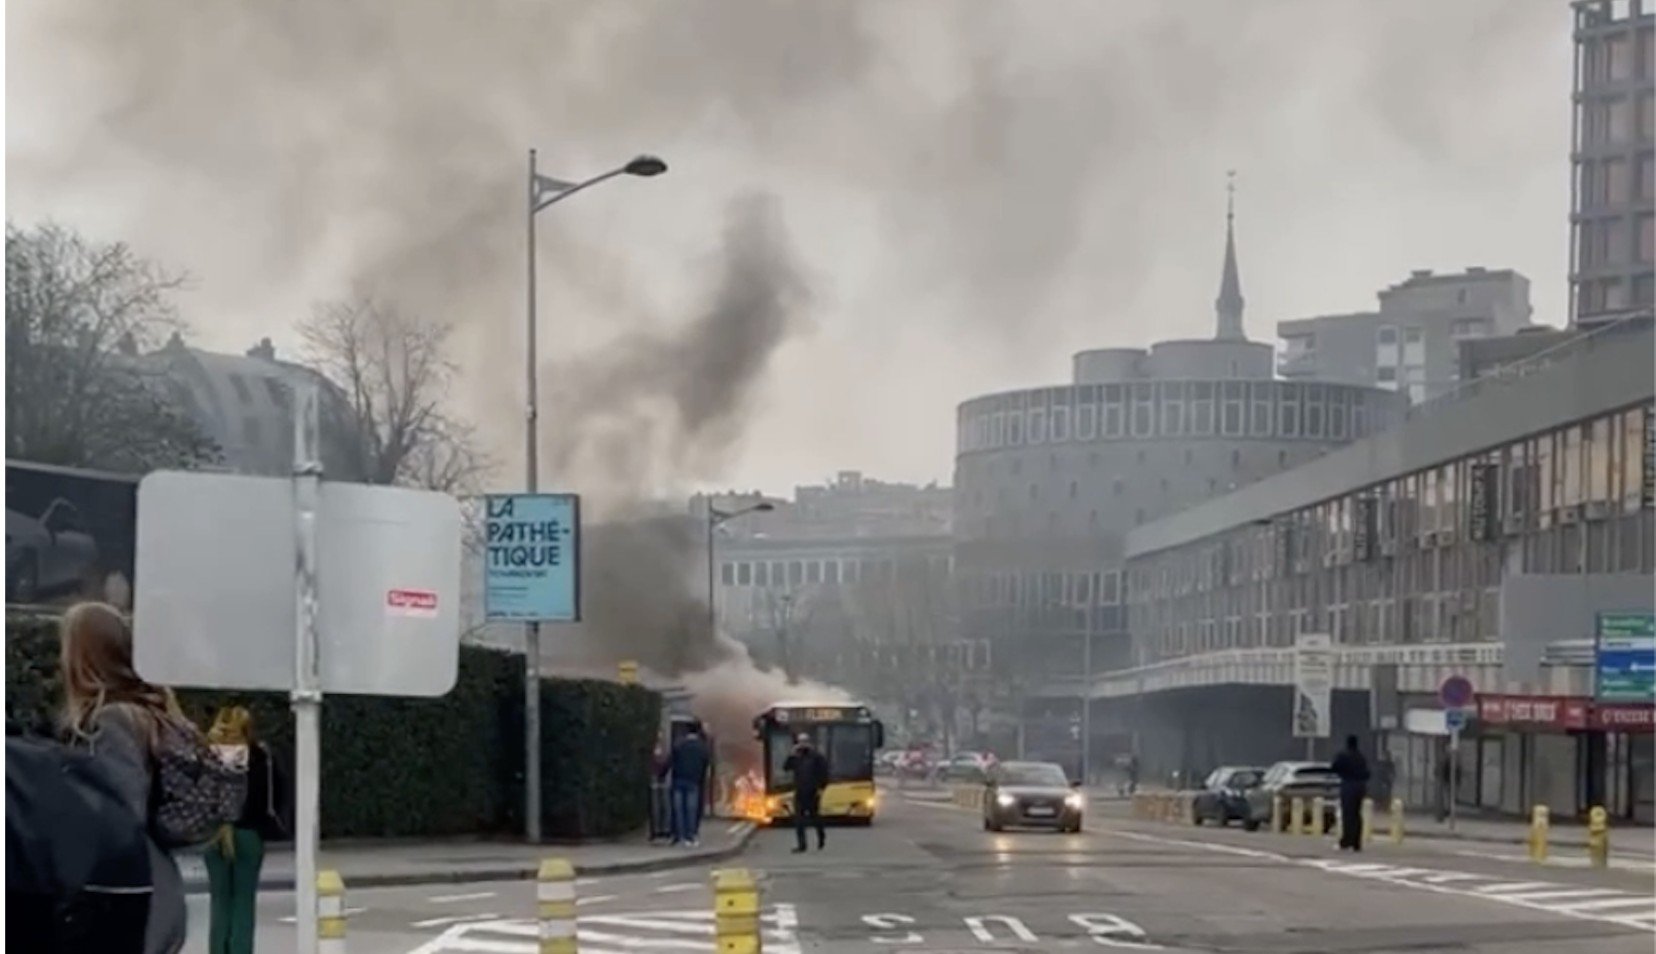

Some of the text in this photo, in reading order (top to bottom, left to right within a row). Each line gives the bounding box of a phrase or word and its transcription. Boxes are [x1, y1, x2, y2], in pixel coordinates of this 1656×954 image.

[488, 498, 513, 518] LA
[487, 520, 570, 542] PATHÉ-
[488, 546, 560, 567] TIQUE
